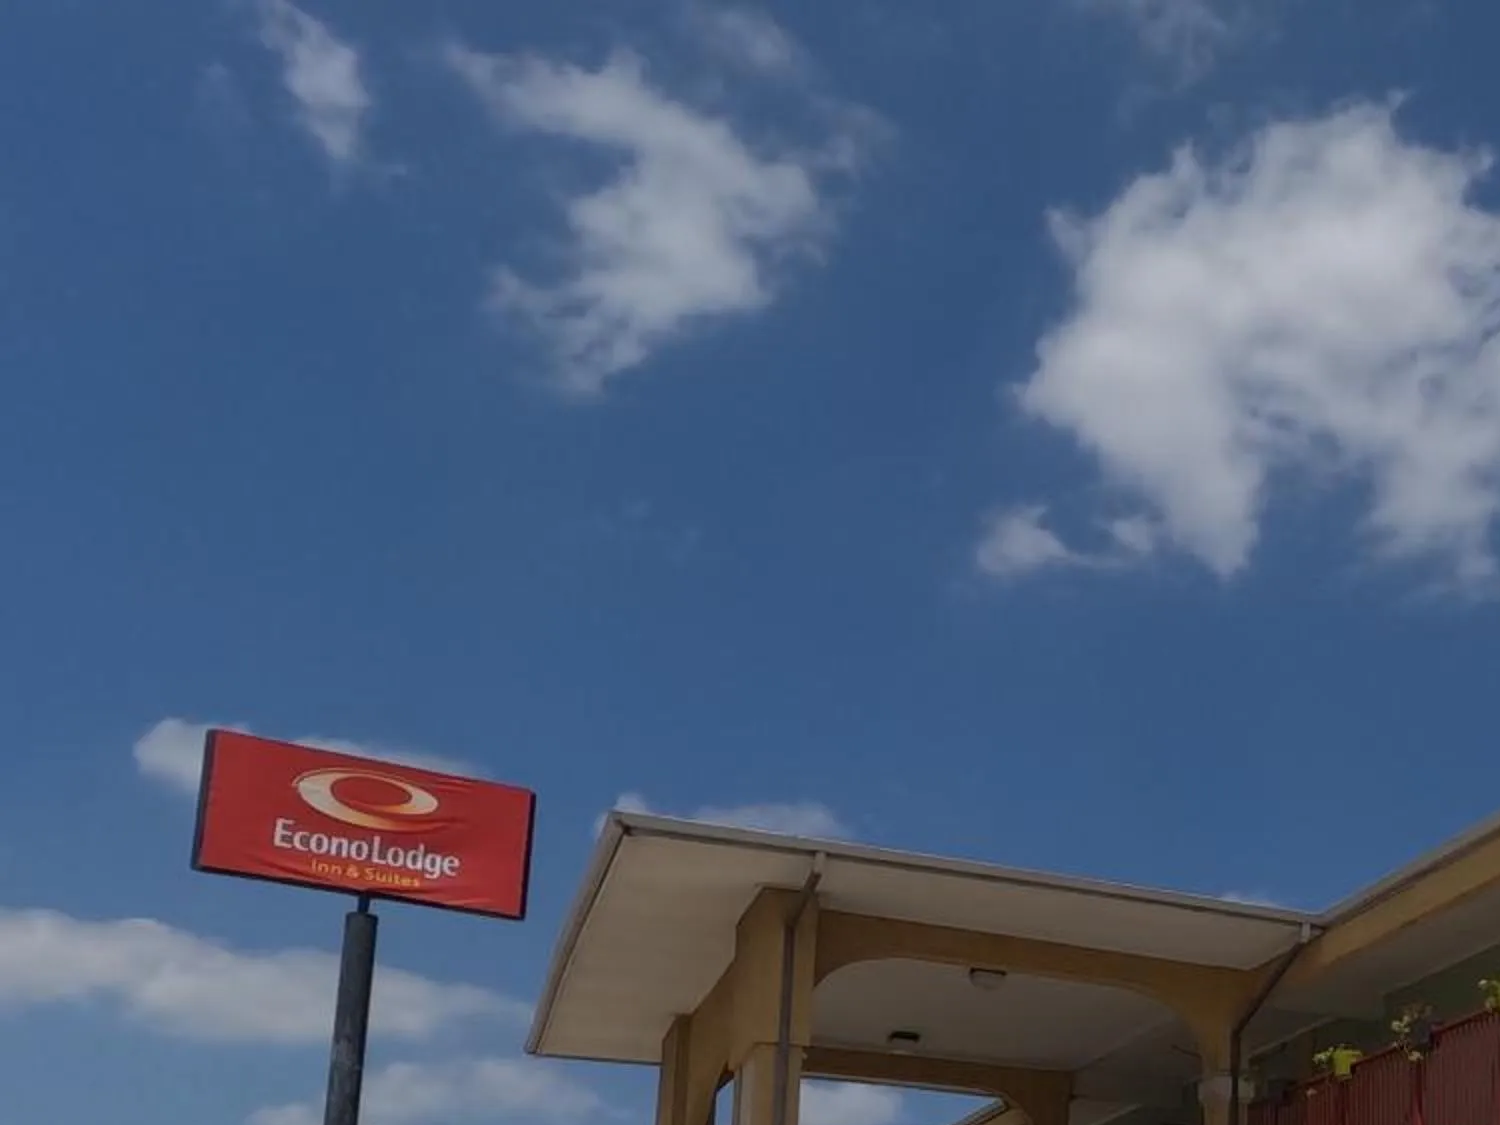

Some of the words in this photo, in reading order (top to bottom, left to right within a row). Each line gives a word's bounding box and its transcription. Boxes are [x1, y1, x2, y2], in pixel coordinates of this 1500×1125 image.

[311, 859, 343, 875] Inn
[344, 865, 360, 879] &
[363, 867, 421, 888] Suites
